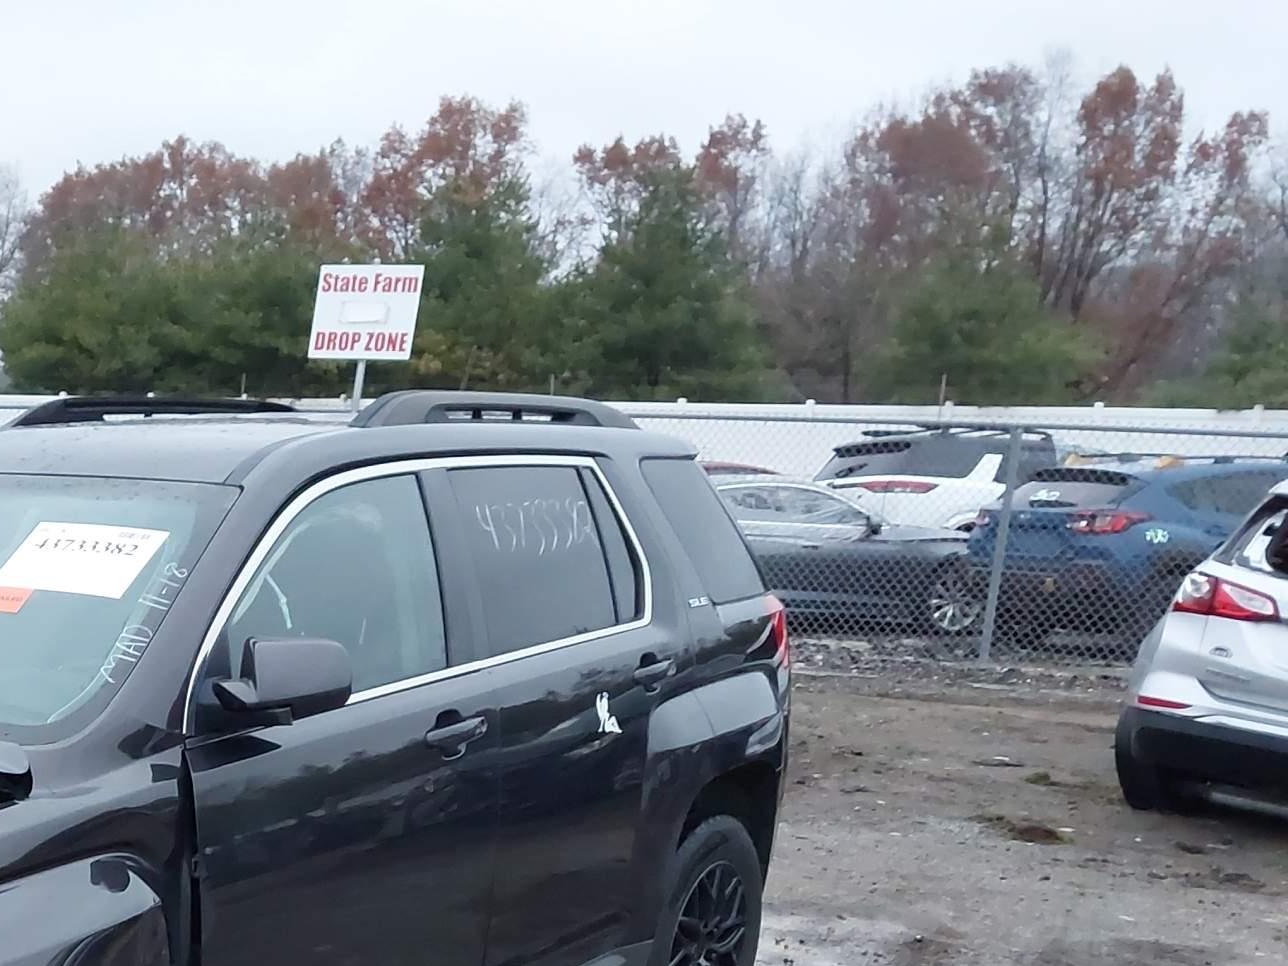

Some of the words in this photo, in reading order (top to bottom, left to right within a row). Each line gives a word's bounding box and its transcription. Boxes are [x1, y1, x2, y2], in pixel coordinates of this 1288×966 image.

[322, 273, 368, 292] State
[373, 273, 418, 293] Farm
[314, 332, 362, 351] DROP
[364, 332, 408, 351] ZONE
[34, 538, 139, 556] 43733382
